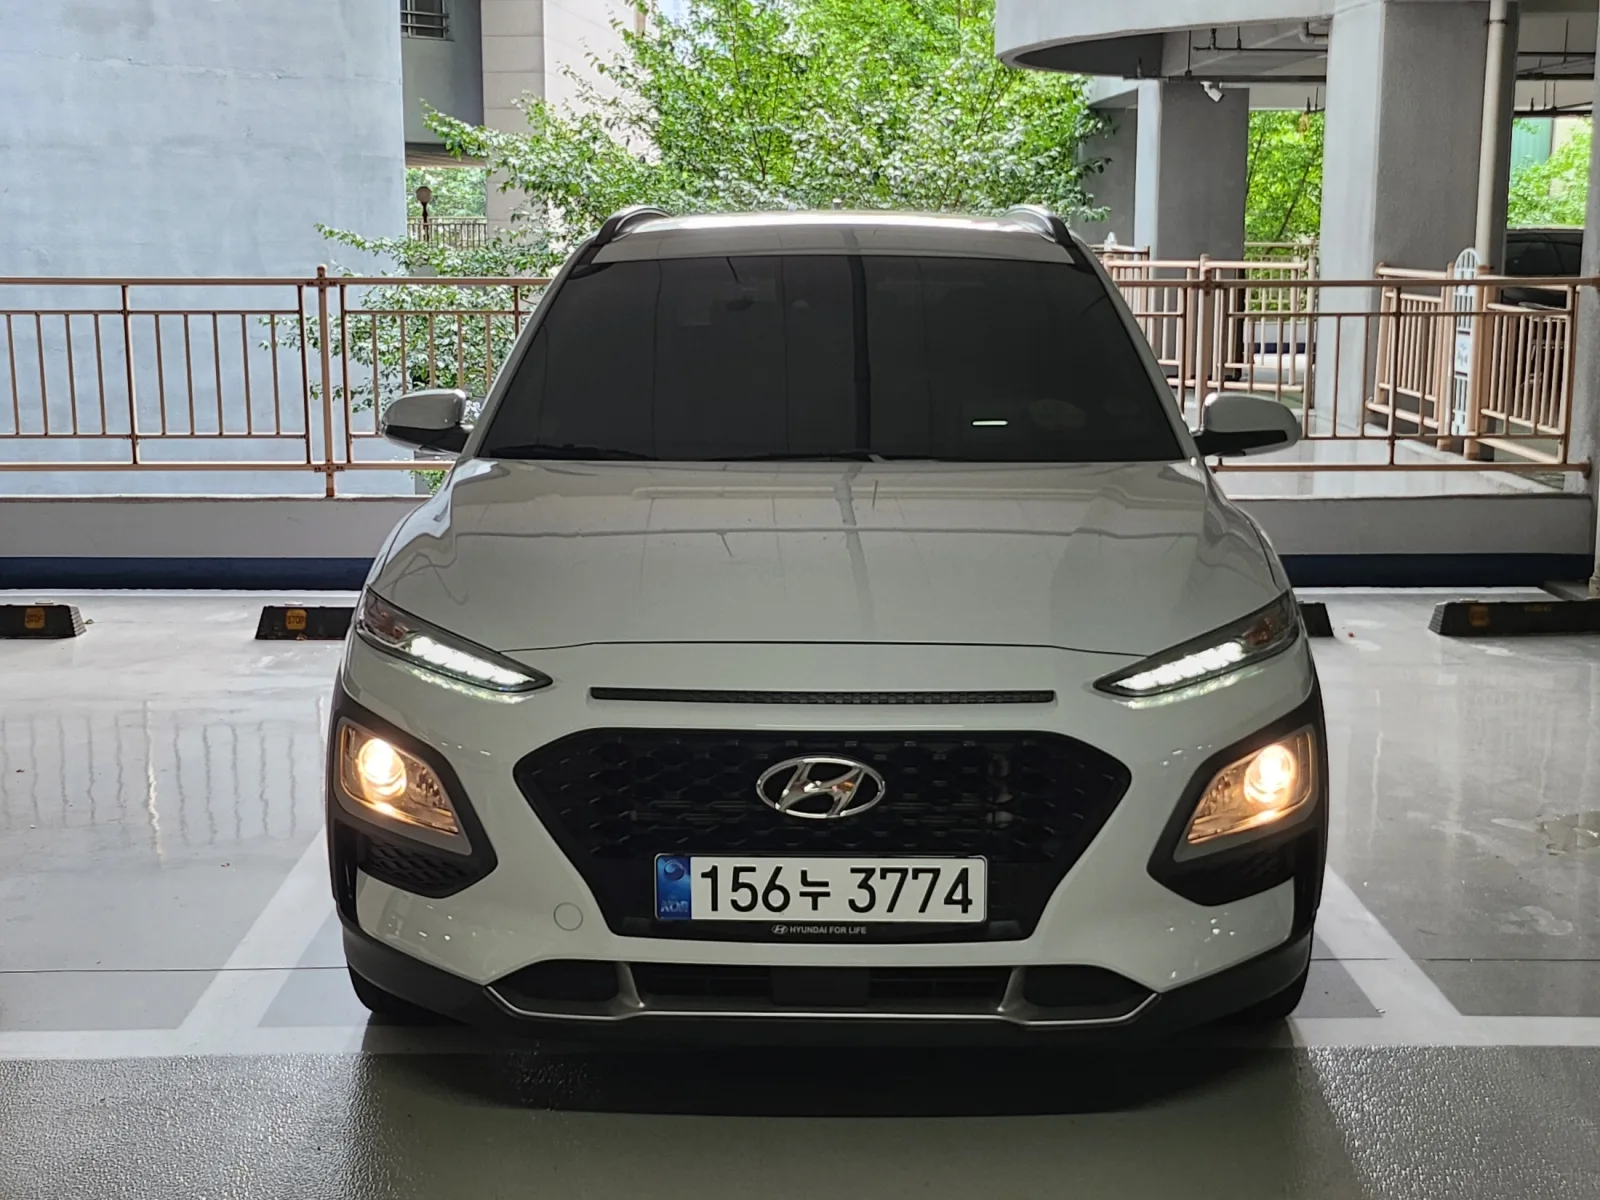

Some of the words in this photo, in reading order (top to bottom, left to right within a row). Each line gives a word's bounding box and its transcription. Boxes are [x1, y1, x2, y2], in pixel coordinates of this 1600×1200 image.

[287, 615, 305, 625] STOP
[700, 865, 831, 913] 156누
[848, 867, 973, 914] 3774
[789, 926, 828, 935] HYUNDAI
[829, 926, 847, 935] FOR
[848, 926, 867, 935] LIFE
